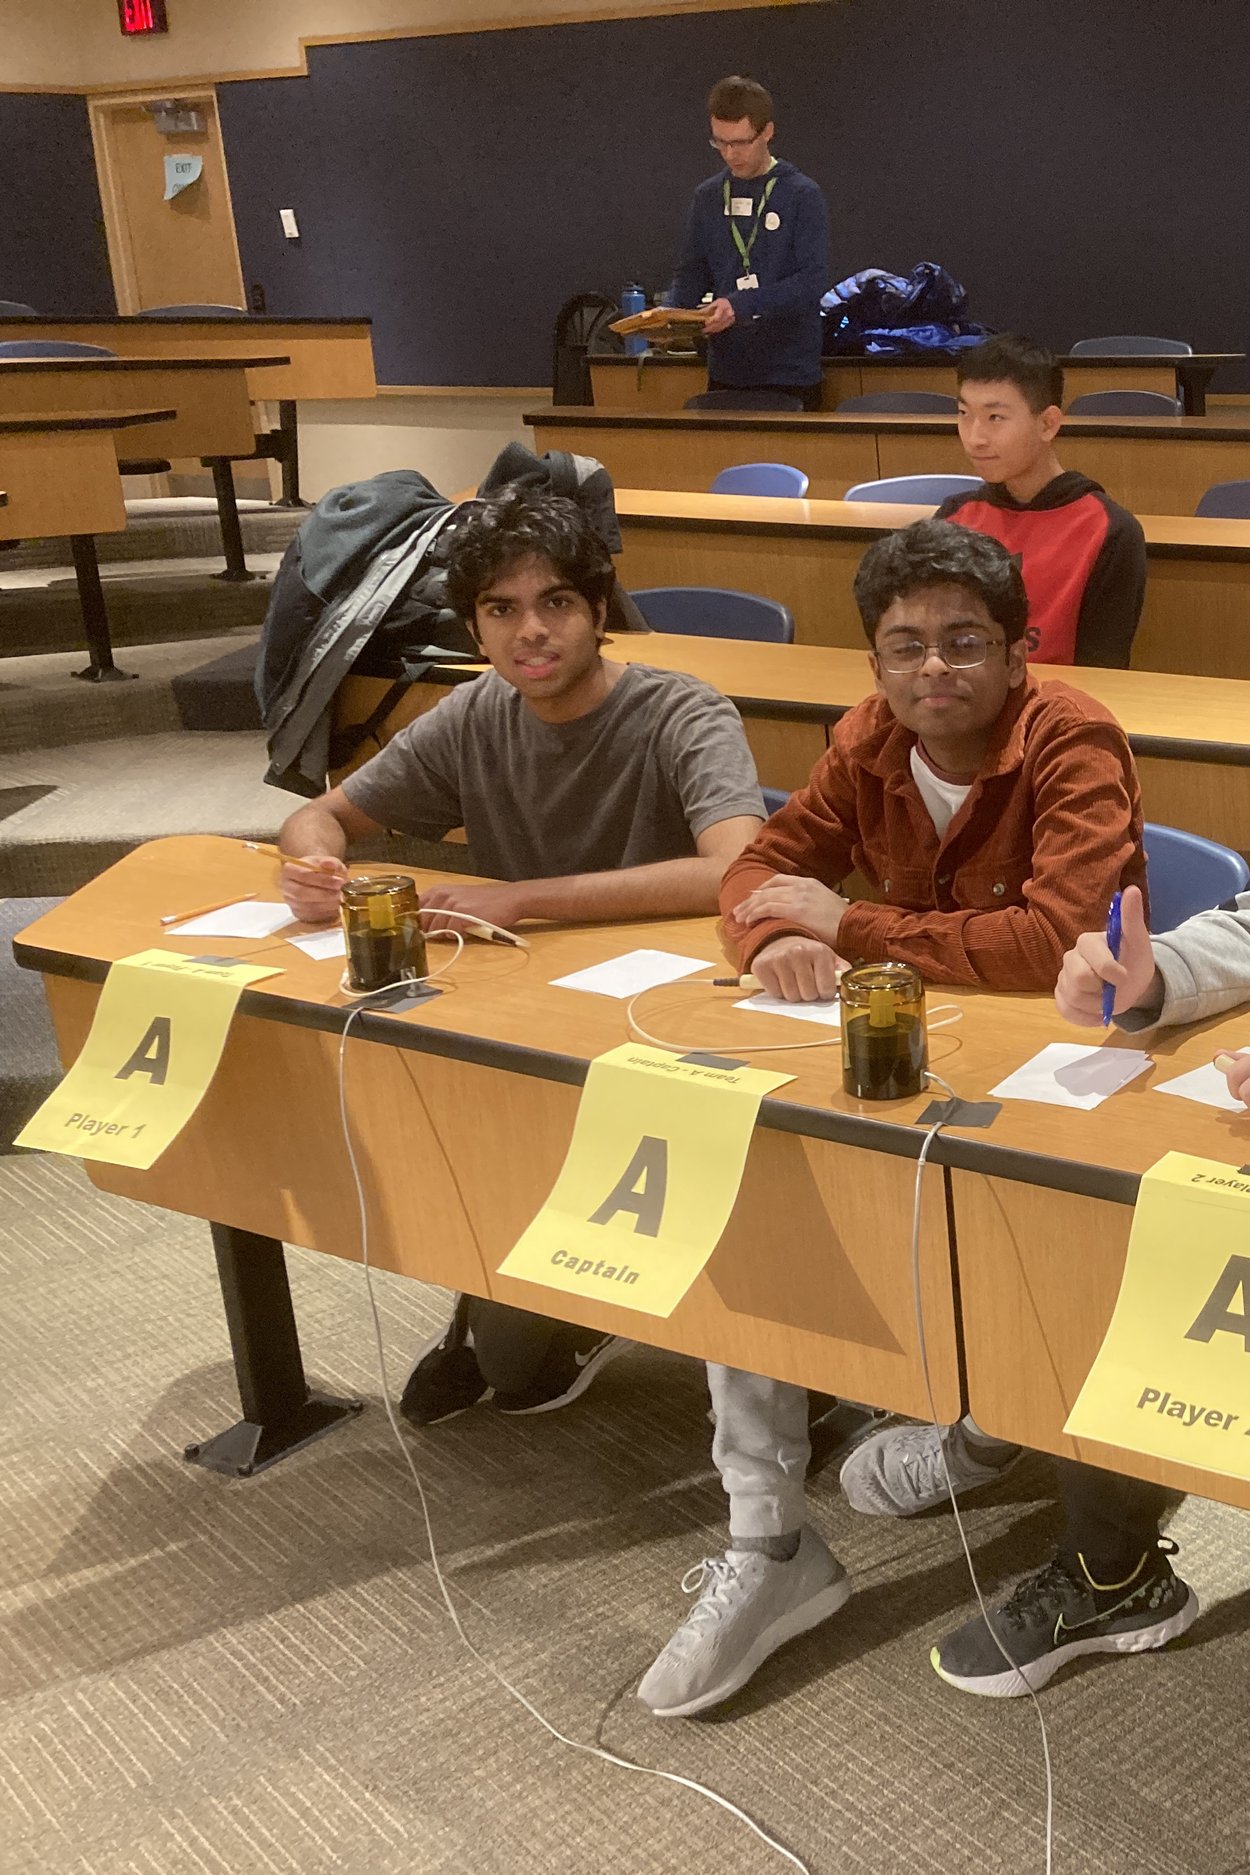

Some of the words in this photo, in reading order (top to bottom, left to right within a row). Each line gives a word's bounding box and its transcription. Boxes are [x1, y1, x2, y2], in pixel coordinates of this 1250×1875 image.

[113, 1016, 172, 1086] A
[627, 1057, 680, 1072] Captain
[64, 1112, 130, 1136] Player
[132, 1123, 147, 1139] 1
[586, 1134, 668, 1238] A
[1191, 1173, 1207, 1183] 2
[549, 1249, 641, 1285] Captain
[1136, 1386, 1240, 1431] Player
